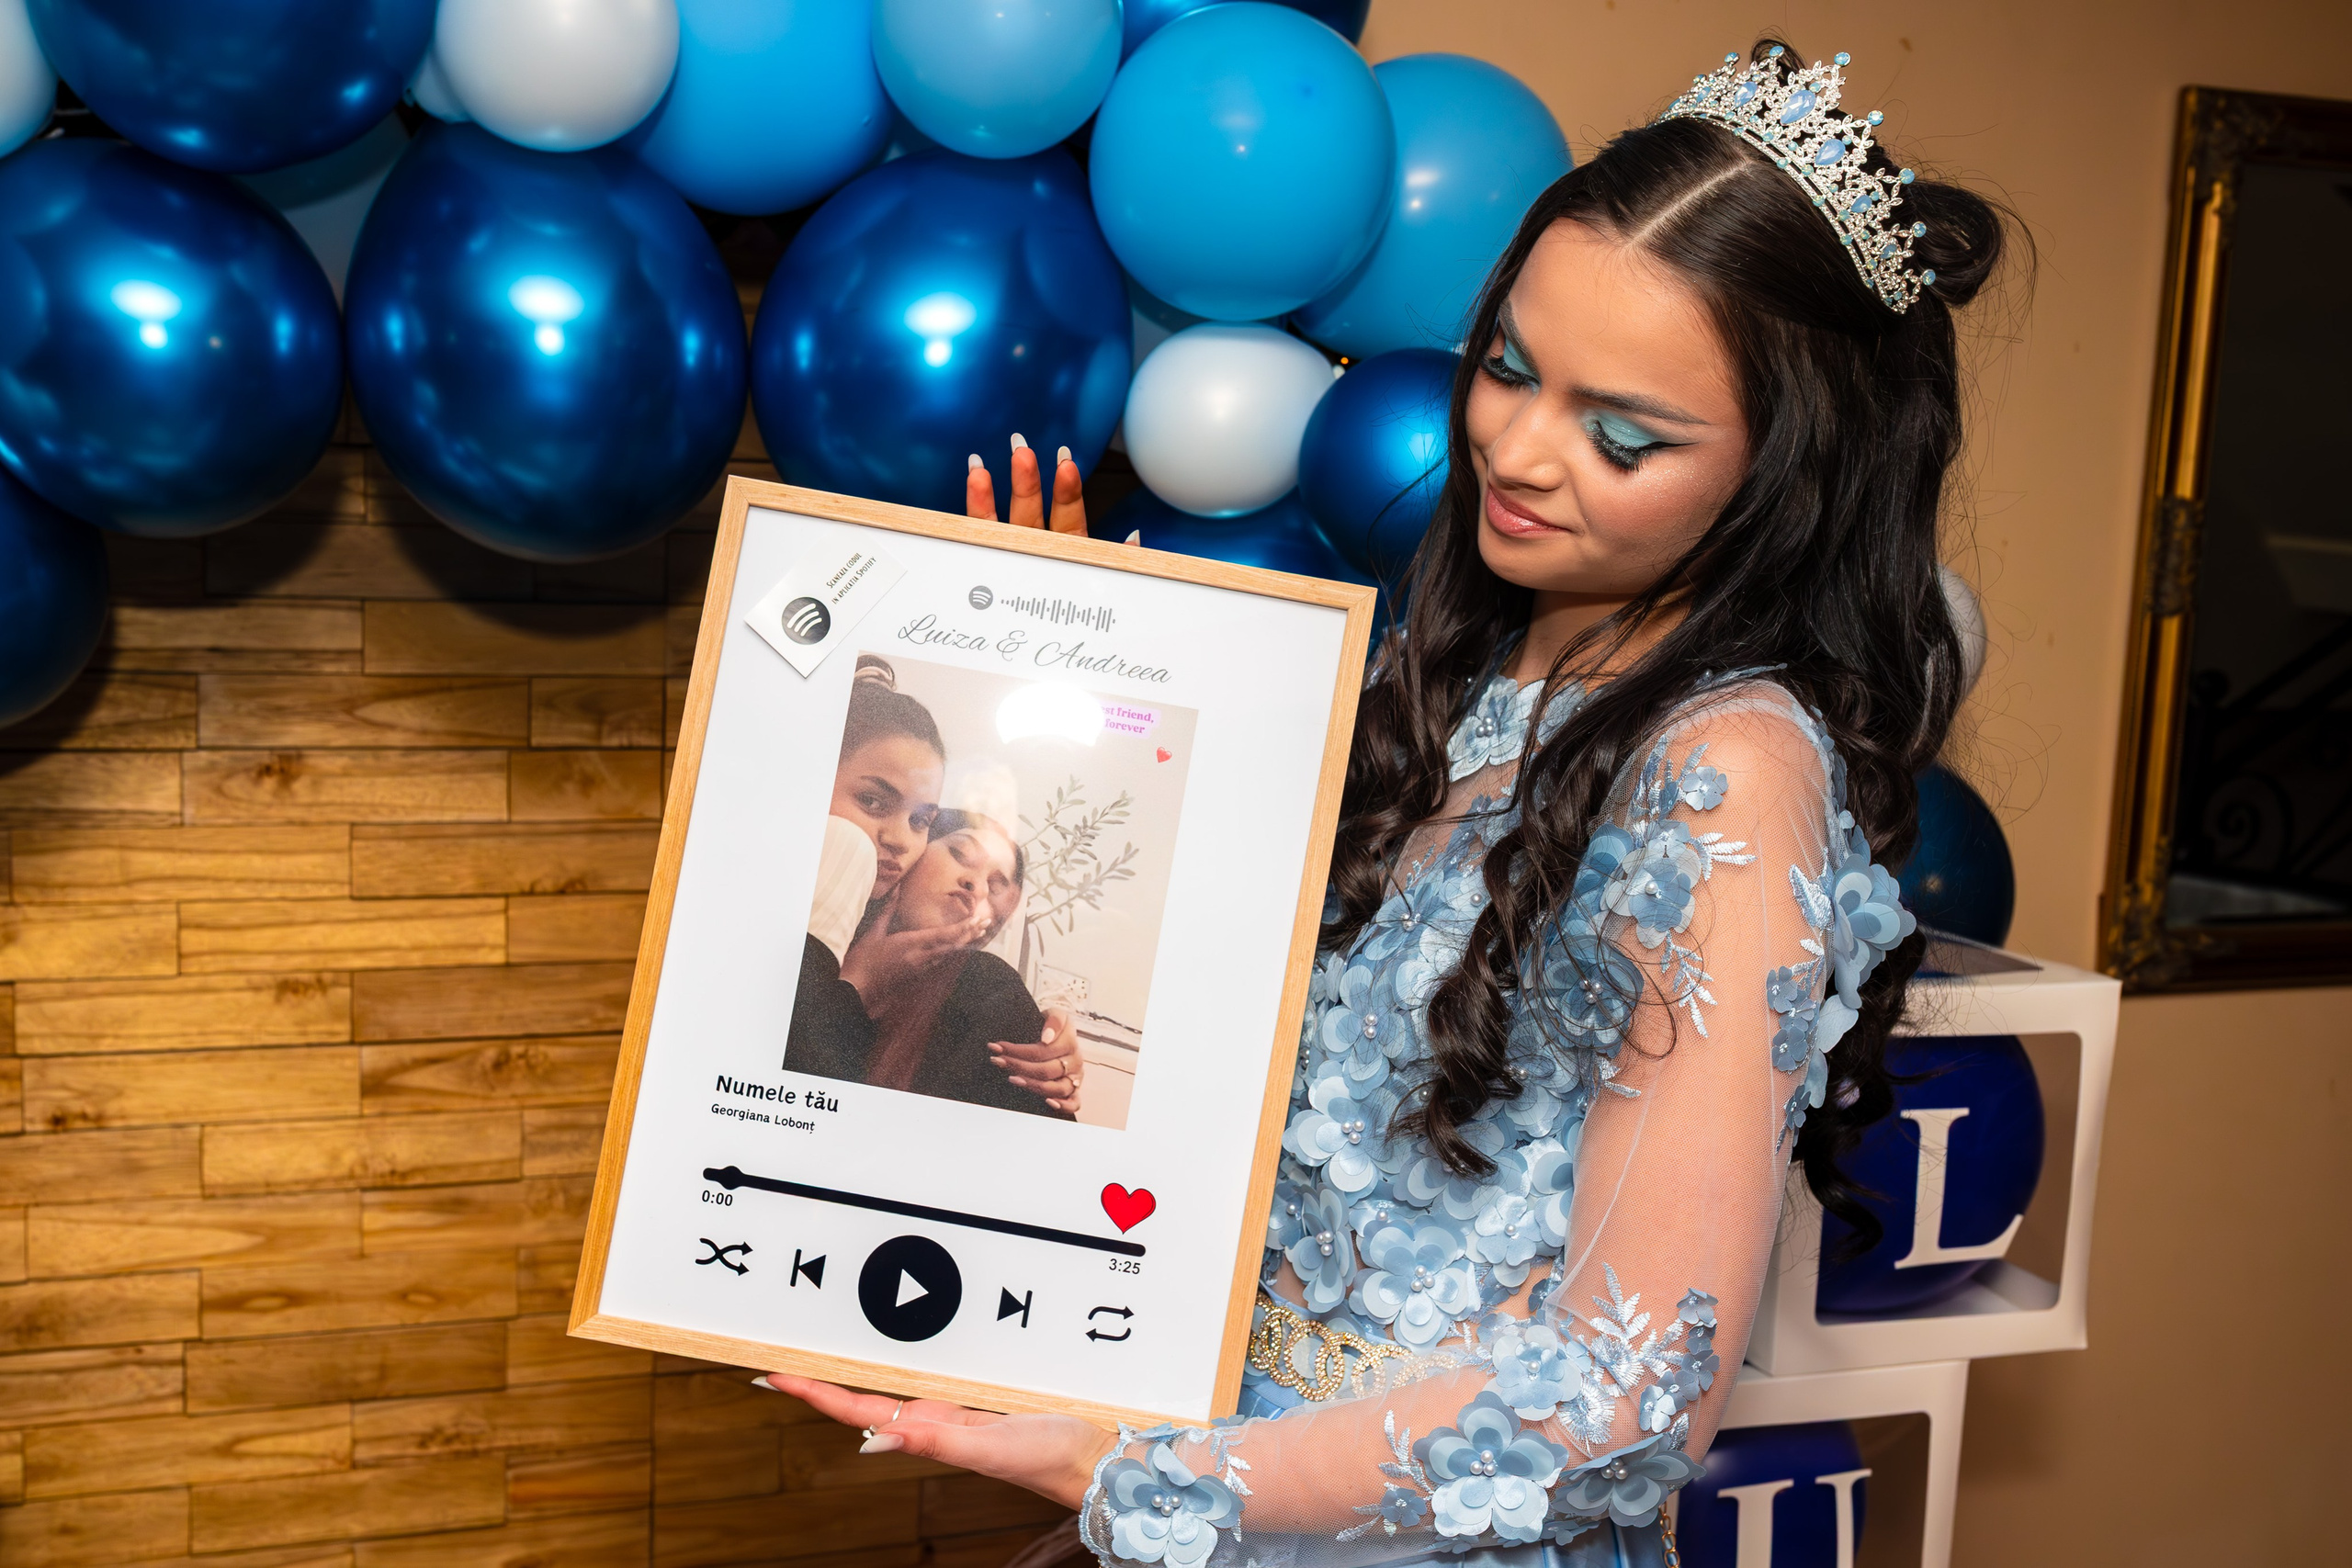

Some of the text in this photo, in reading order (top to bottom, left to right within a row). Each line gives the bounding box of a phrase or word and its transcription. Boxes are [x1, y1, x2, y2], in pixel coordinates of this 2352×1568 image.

[898, 614, 1172, 682] Luiza & Andreea
[1102, 706, 1154, 724] est friend,
[1105, 718, 1146, 734] forever
[715, 1075, 838, 1113] Numele tău
[711, 1103, 815, 1134] Georgiana Lobonț
[701, 1190, 733, 1207] 0:00
[1894, 1107, 2024, 1269] L
[1109, 1258, 1140, 1275] 3:25
